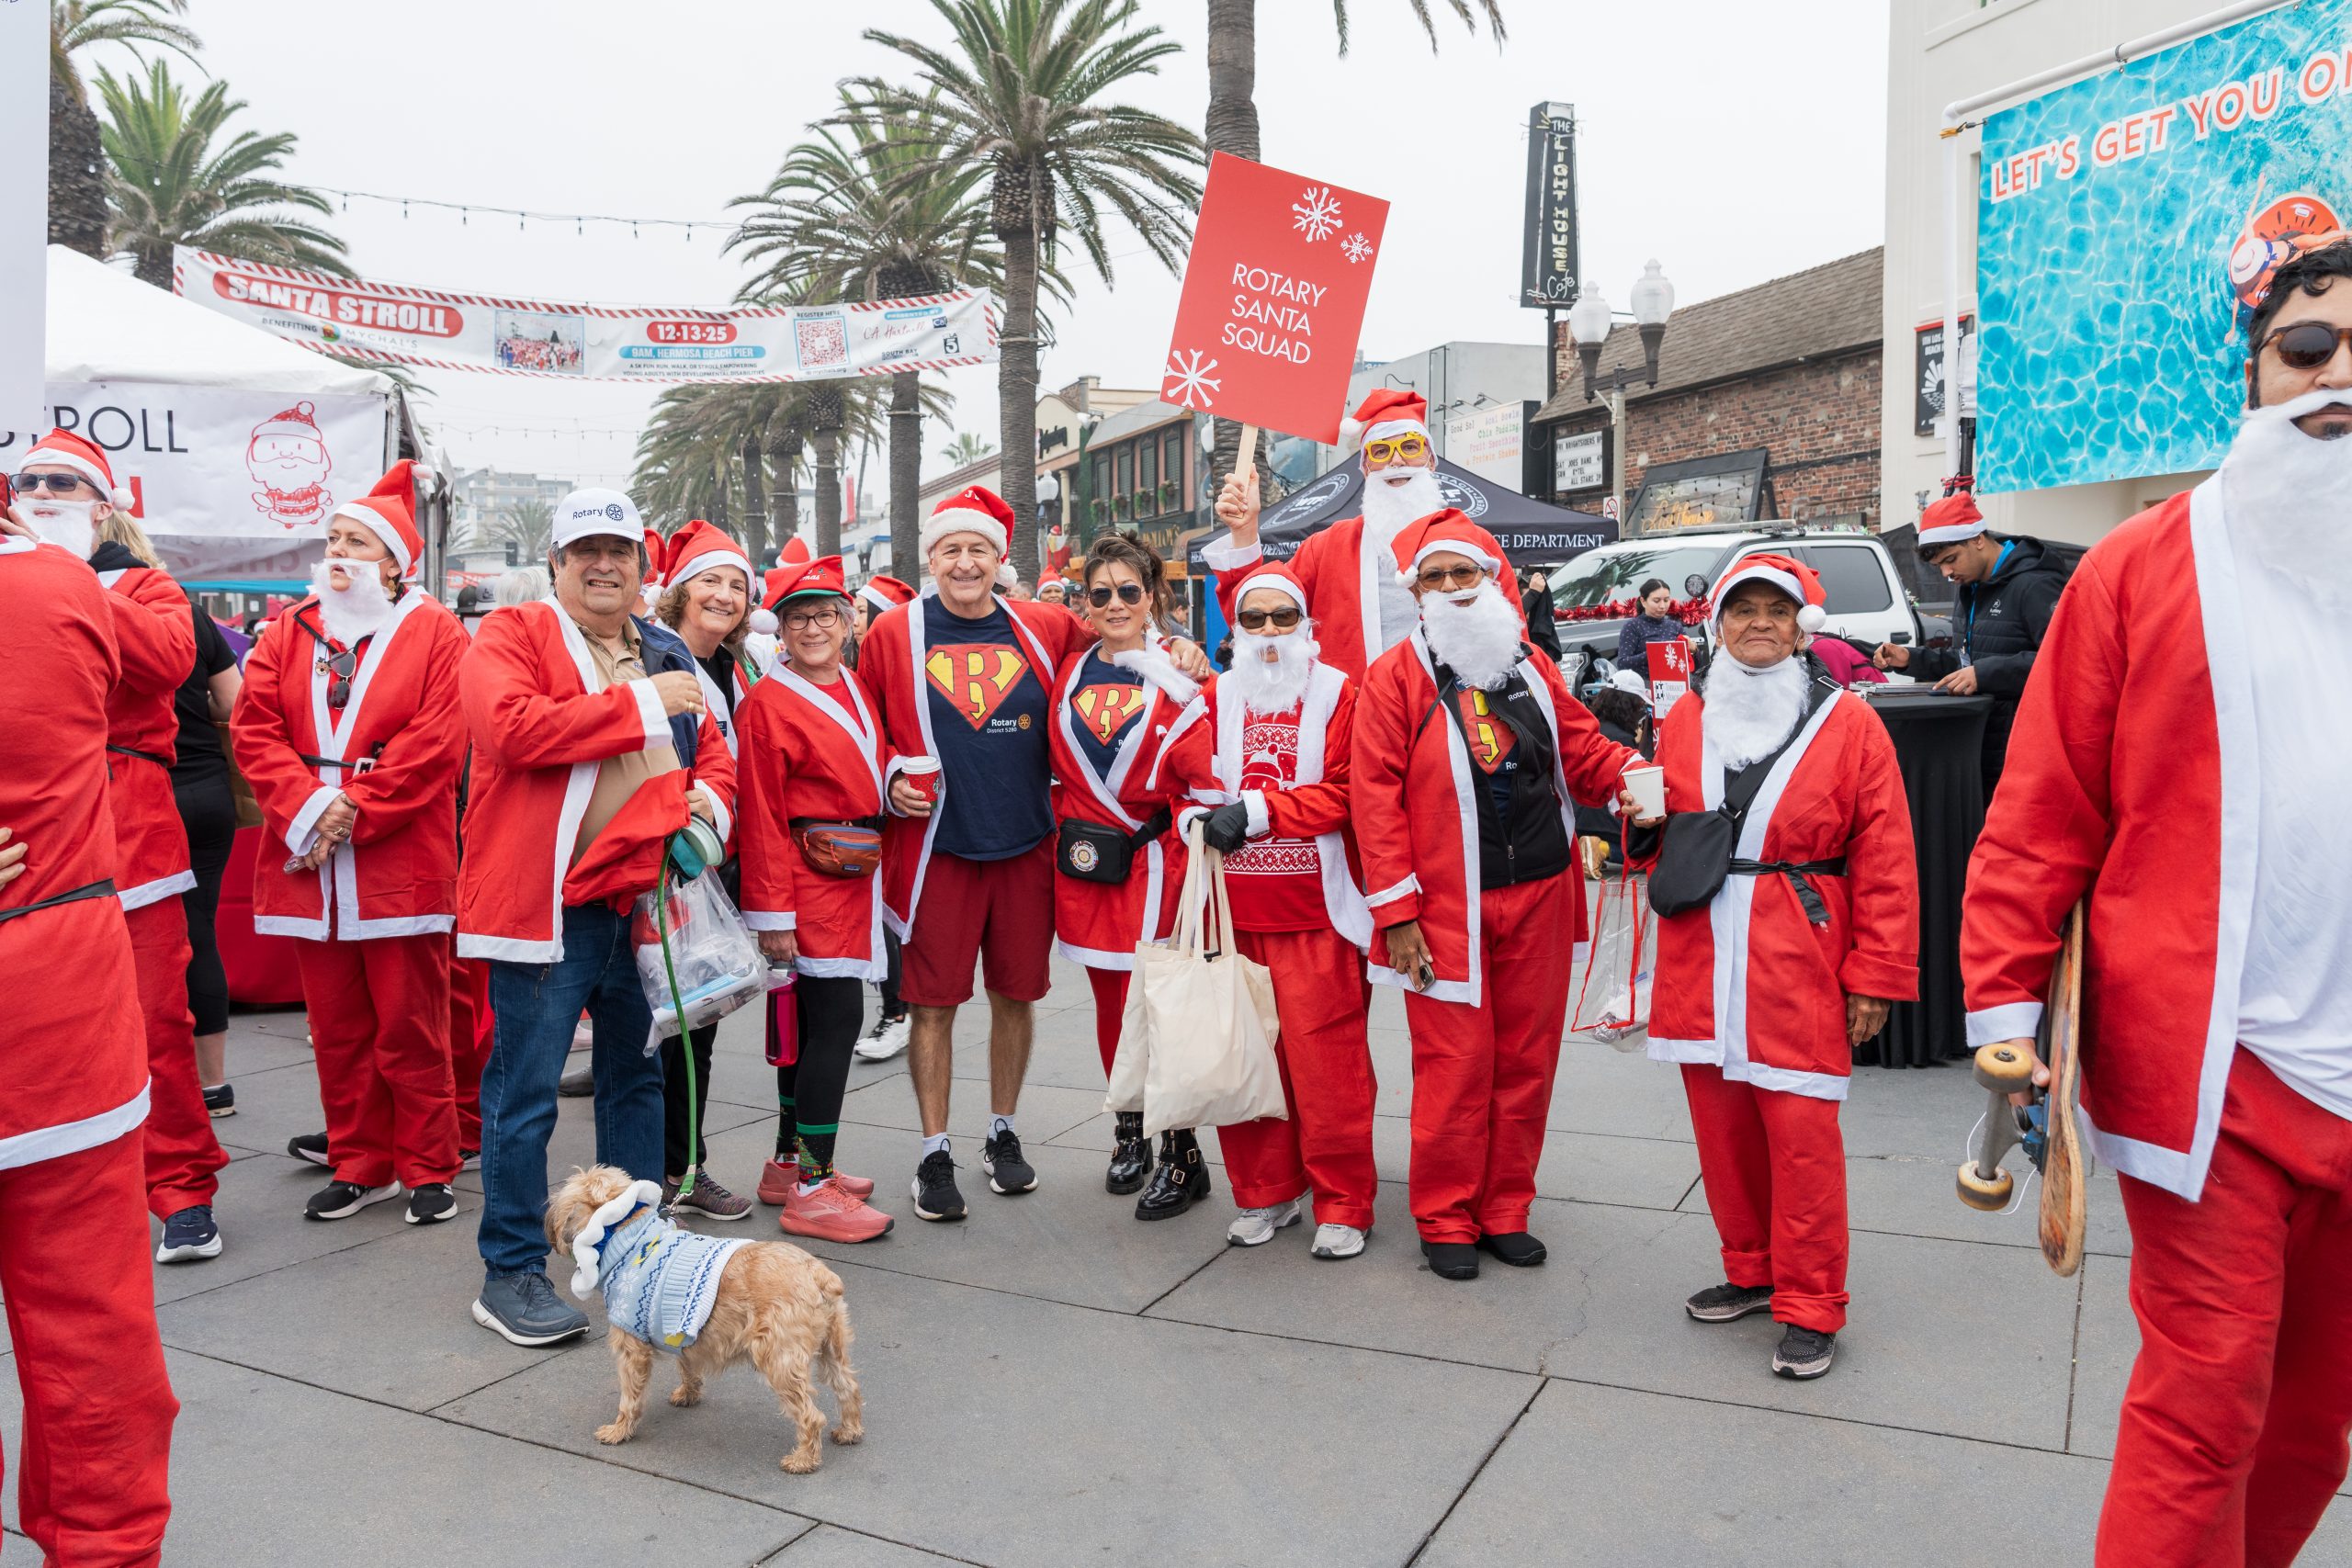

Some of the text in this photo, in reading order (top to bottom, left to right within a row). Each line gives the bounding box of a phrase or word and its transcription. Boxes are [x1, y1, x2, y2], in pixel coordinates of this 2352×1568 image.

[1551, 120, 1572, 133] THE
[1993, 137, 2078, 199] LET'S
[2094, 104, 2176, 166] GET
[2184, 68, 2282, 139] YOU
[1552, 135, 1568, 201] LIGHT
[1232, 263, 1328, 307] ROTARY
[228, 275, 448, 334] SANTA STROLL
[1231, 294, 1311, 336] SANTA
[262, 317, 318, 333] BENEFITING
[345, 328, 418, 348] MYCHAL'S
[1221, 322, 1311, 364] SQUAD
[657, 347, 701, 358] HERMOSA
[703, 347, 732, 358] BEACH
[734, 347, 753, 357] PIER
[882, 349, 904, 357] SOUTH
[572, 507, 604, 521] Rotary
[1513, 534, 1604, 547] DEPARTMENT
[1508, 689, 1530, 702] Rotary
[991, 718, 1017, 727] Rotary
